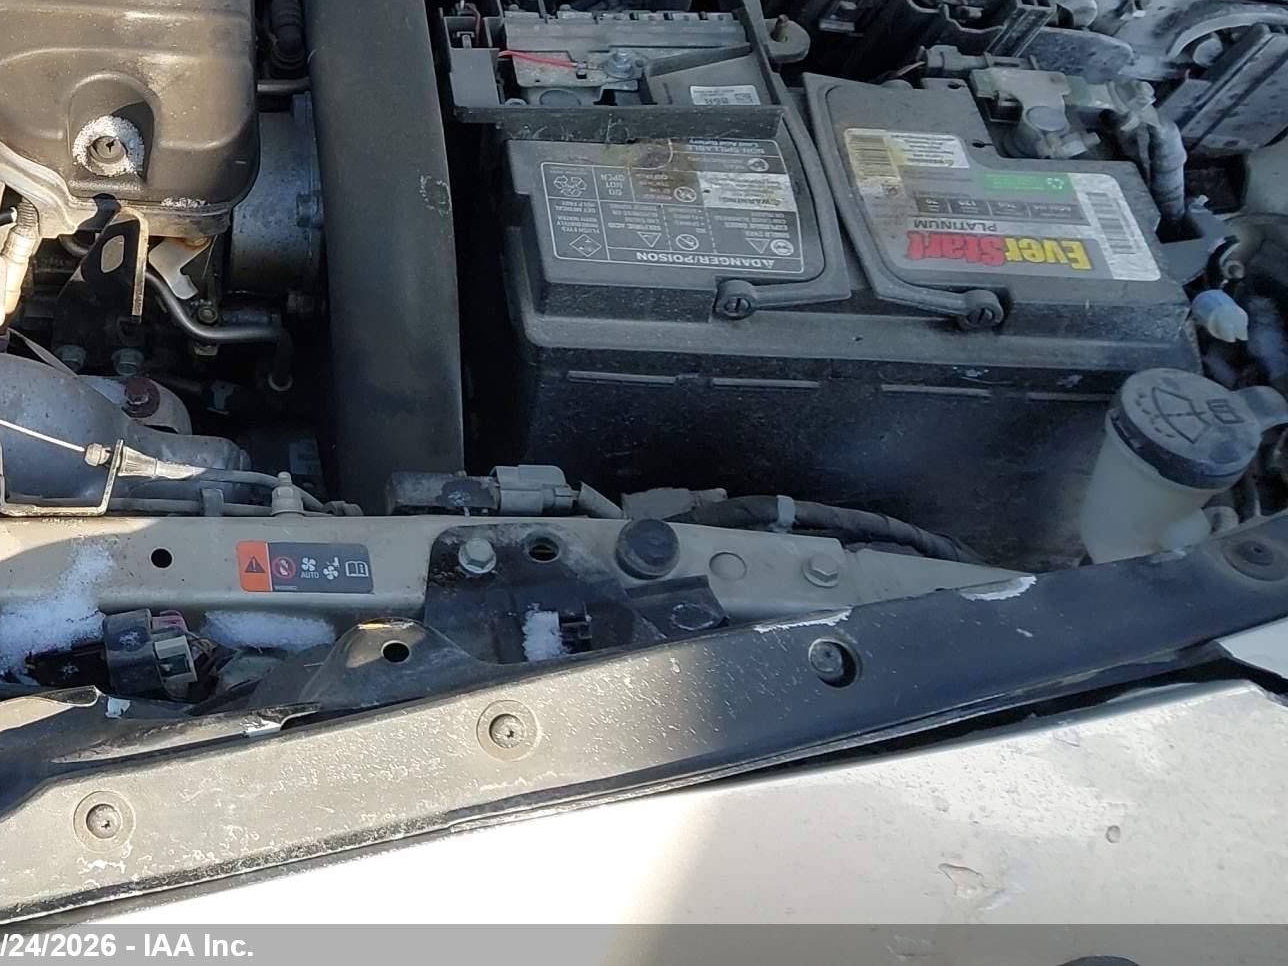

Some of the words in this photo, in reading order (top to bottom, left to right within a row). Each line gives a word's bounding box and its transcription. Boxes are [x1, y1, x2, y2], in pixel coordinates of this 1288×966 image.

[913, 218, 998, 233] PLATINUM
[636, 251, 763, 268] DANGER/POISON
[906, 231, 1093, 272] EverStart
[300, 571, 320, 579] AUTO
